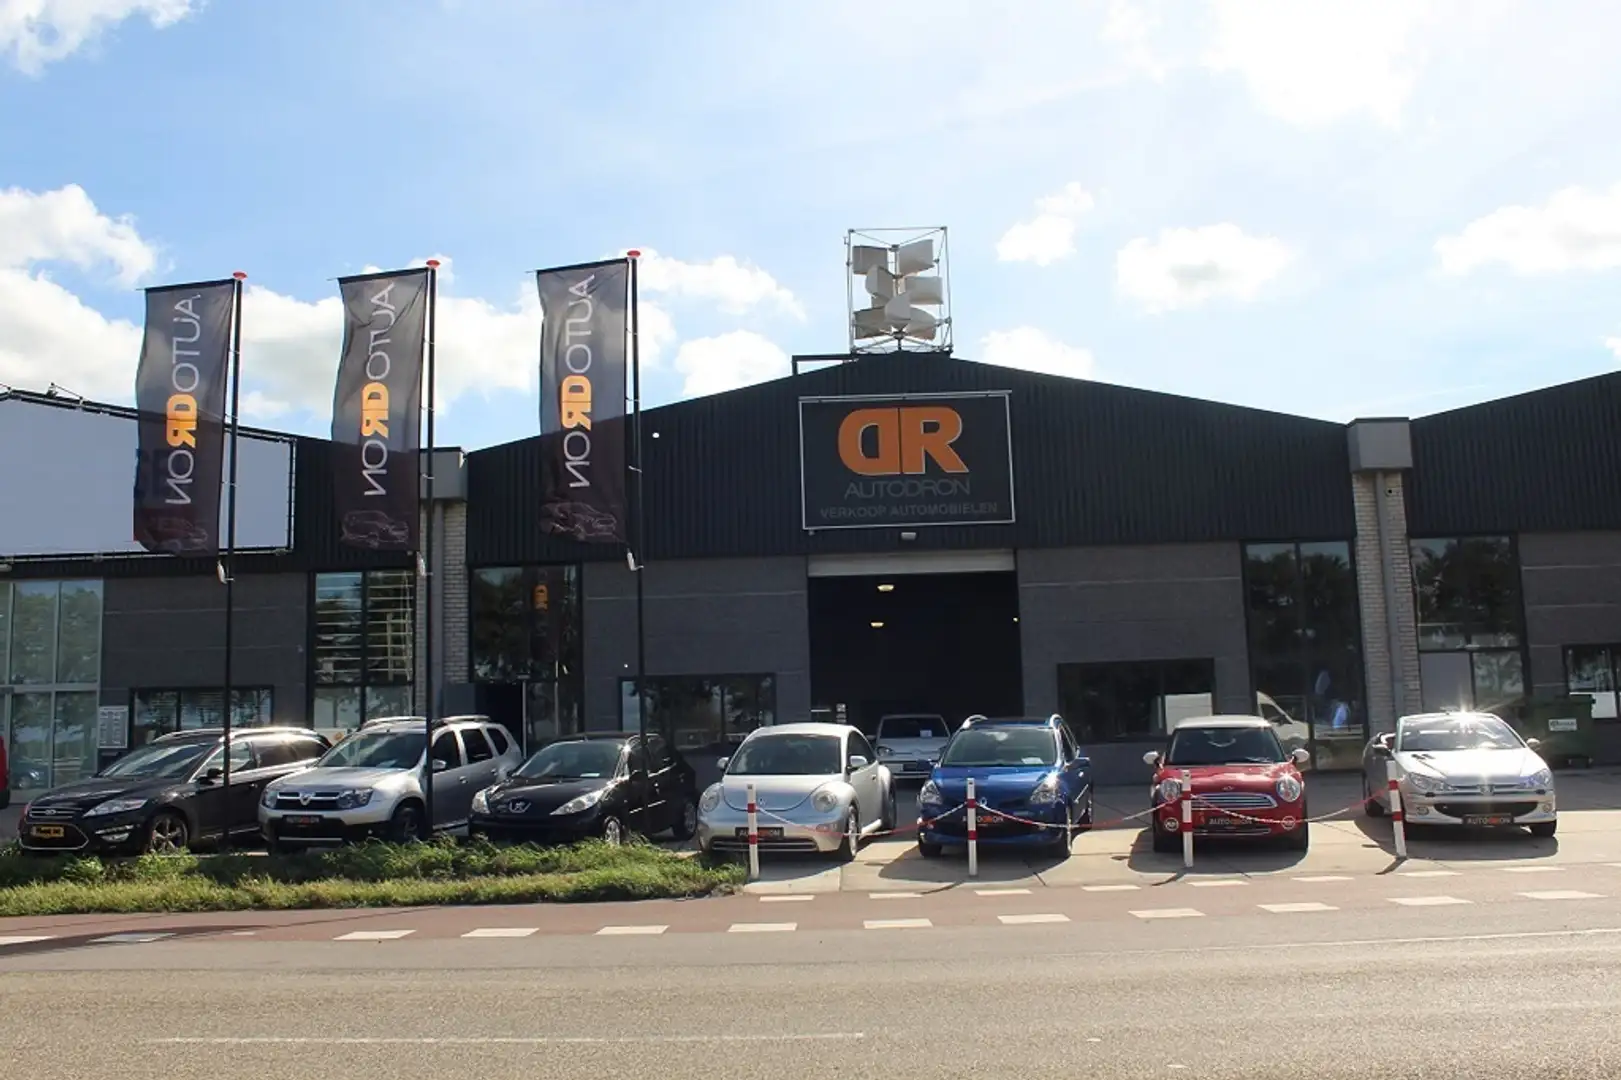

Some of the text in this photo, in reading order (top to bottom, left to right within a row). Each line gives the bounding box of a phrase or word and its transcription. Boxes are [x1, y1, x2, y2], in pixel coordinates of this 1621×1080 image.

[844, 478, 971, 500] AUTODRON
[820, 501, 998, 519] VERKOOP AUTOMOBIELEN
